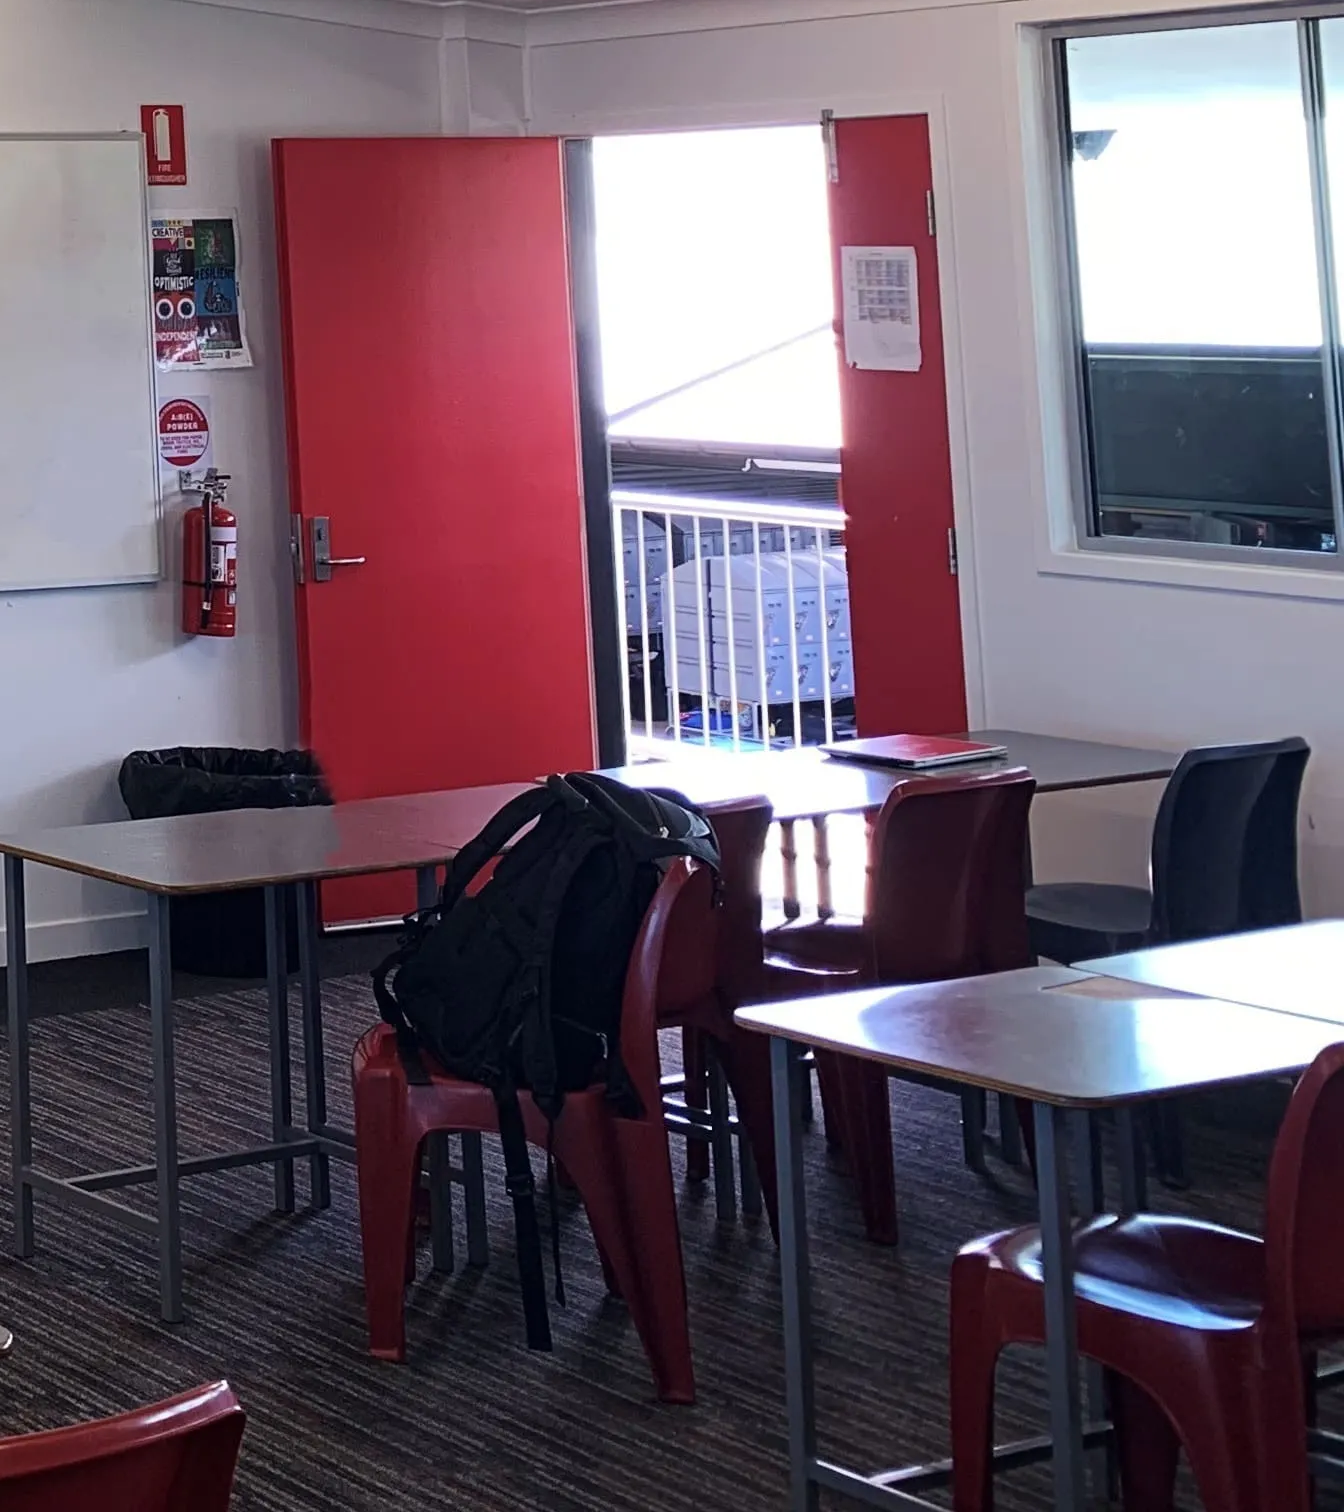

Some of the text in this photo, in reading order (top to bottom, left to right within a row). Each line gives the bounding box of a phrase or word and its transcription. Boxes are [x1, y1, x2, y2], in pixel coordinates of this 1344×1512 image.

[158, 164, 172, 172] FIRE
[152, 228, 184, 237] CREATIVE
[154, 276, 194, 291] OPTIMISTIC
[166, 422, 198, 431] POWDER
